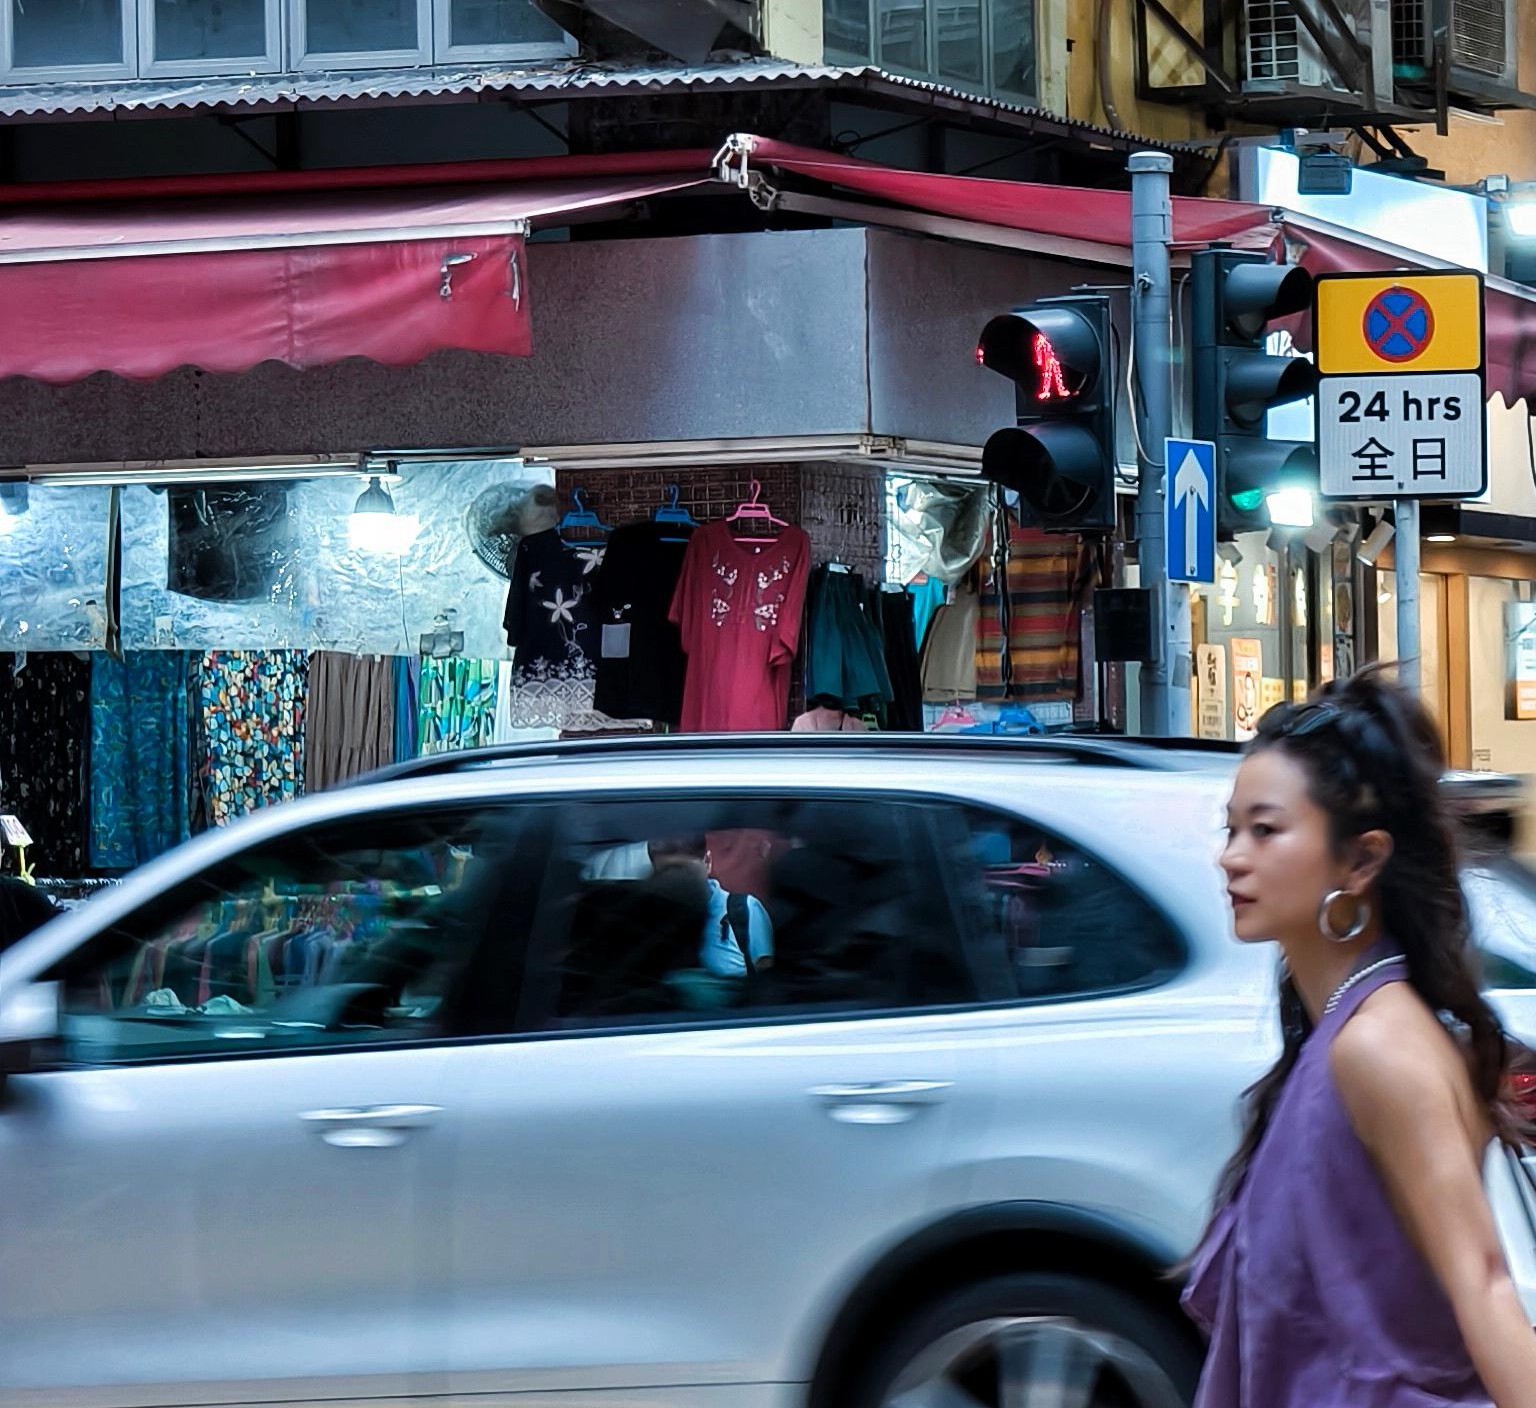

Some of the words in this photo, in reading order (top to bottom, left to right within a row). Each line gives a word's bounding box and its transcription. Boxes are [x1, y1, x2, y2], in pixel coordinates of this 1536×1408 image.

[1338, 391, 1390, 423] 24
[1403, 391, 1462, 422] hrs
[1351, 437, 1447, 482] 全日
